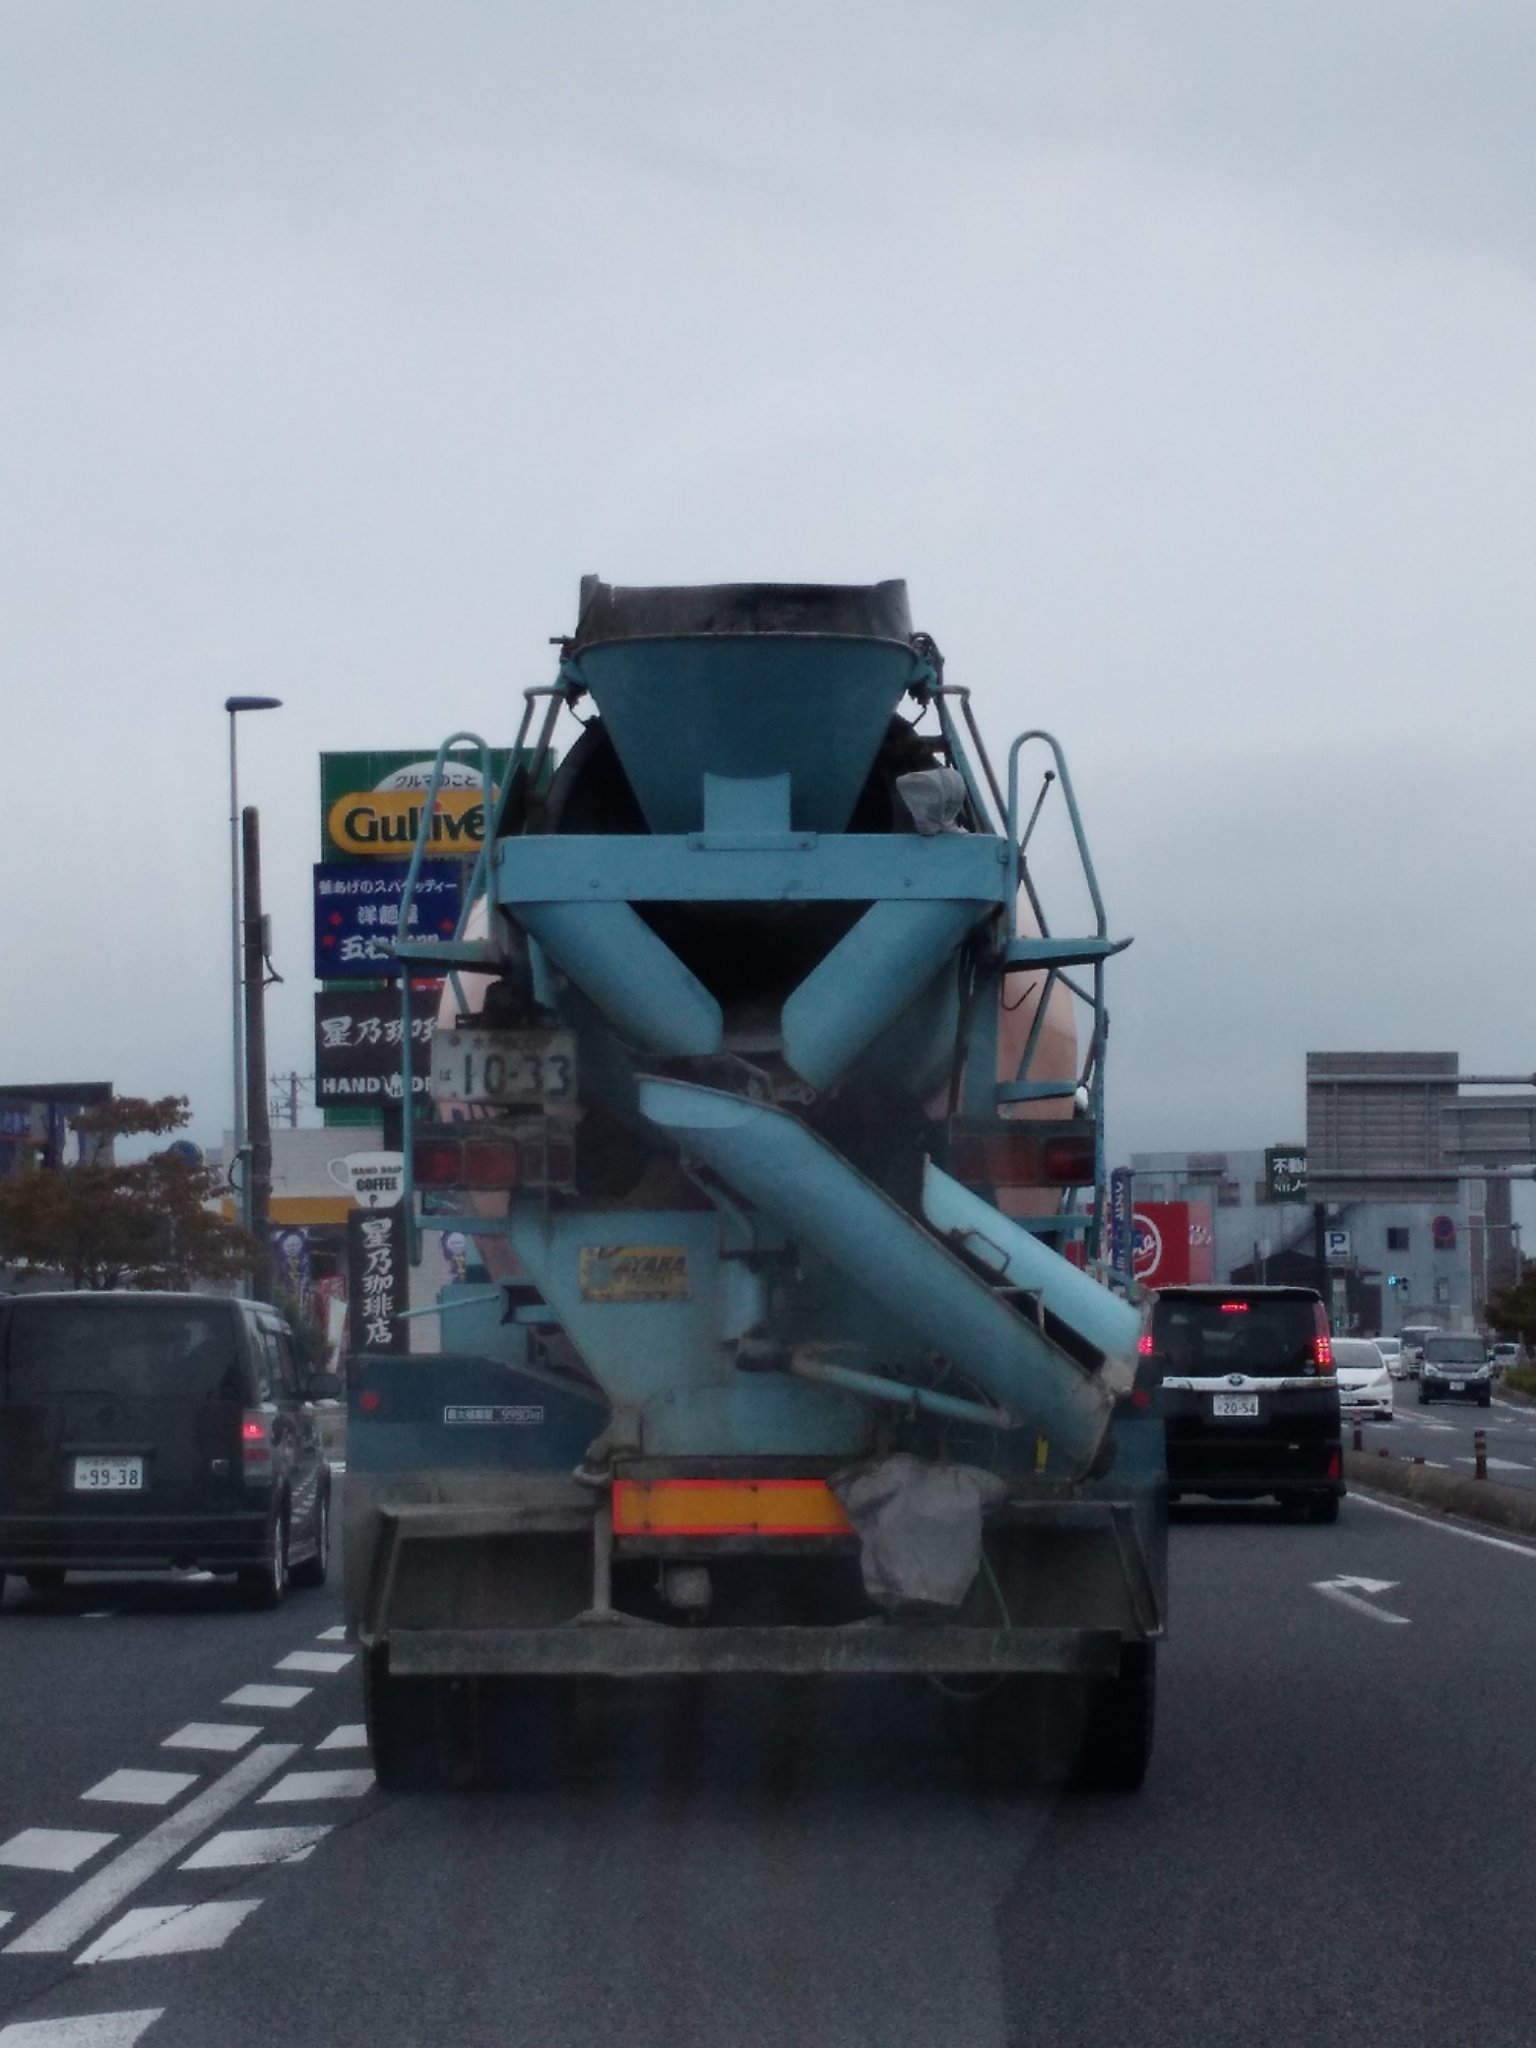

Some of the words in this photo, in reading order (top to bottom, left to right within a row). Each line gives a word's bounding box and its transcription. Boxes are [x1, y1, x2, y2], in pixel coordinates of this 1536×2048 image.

[319, 879, 458, 895] 釜あげのスパッティー
[322, 1077, 381, 1094] HAND
[356, 1177, 398, 1191] COFFEE
[1330, 1233, 1346, 1248] P
[361, 1217, 394, 1346] 星乃珈琲店
[89, 1469, 139, 1487] 99-38
